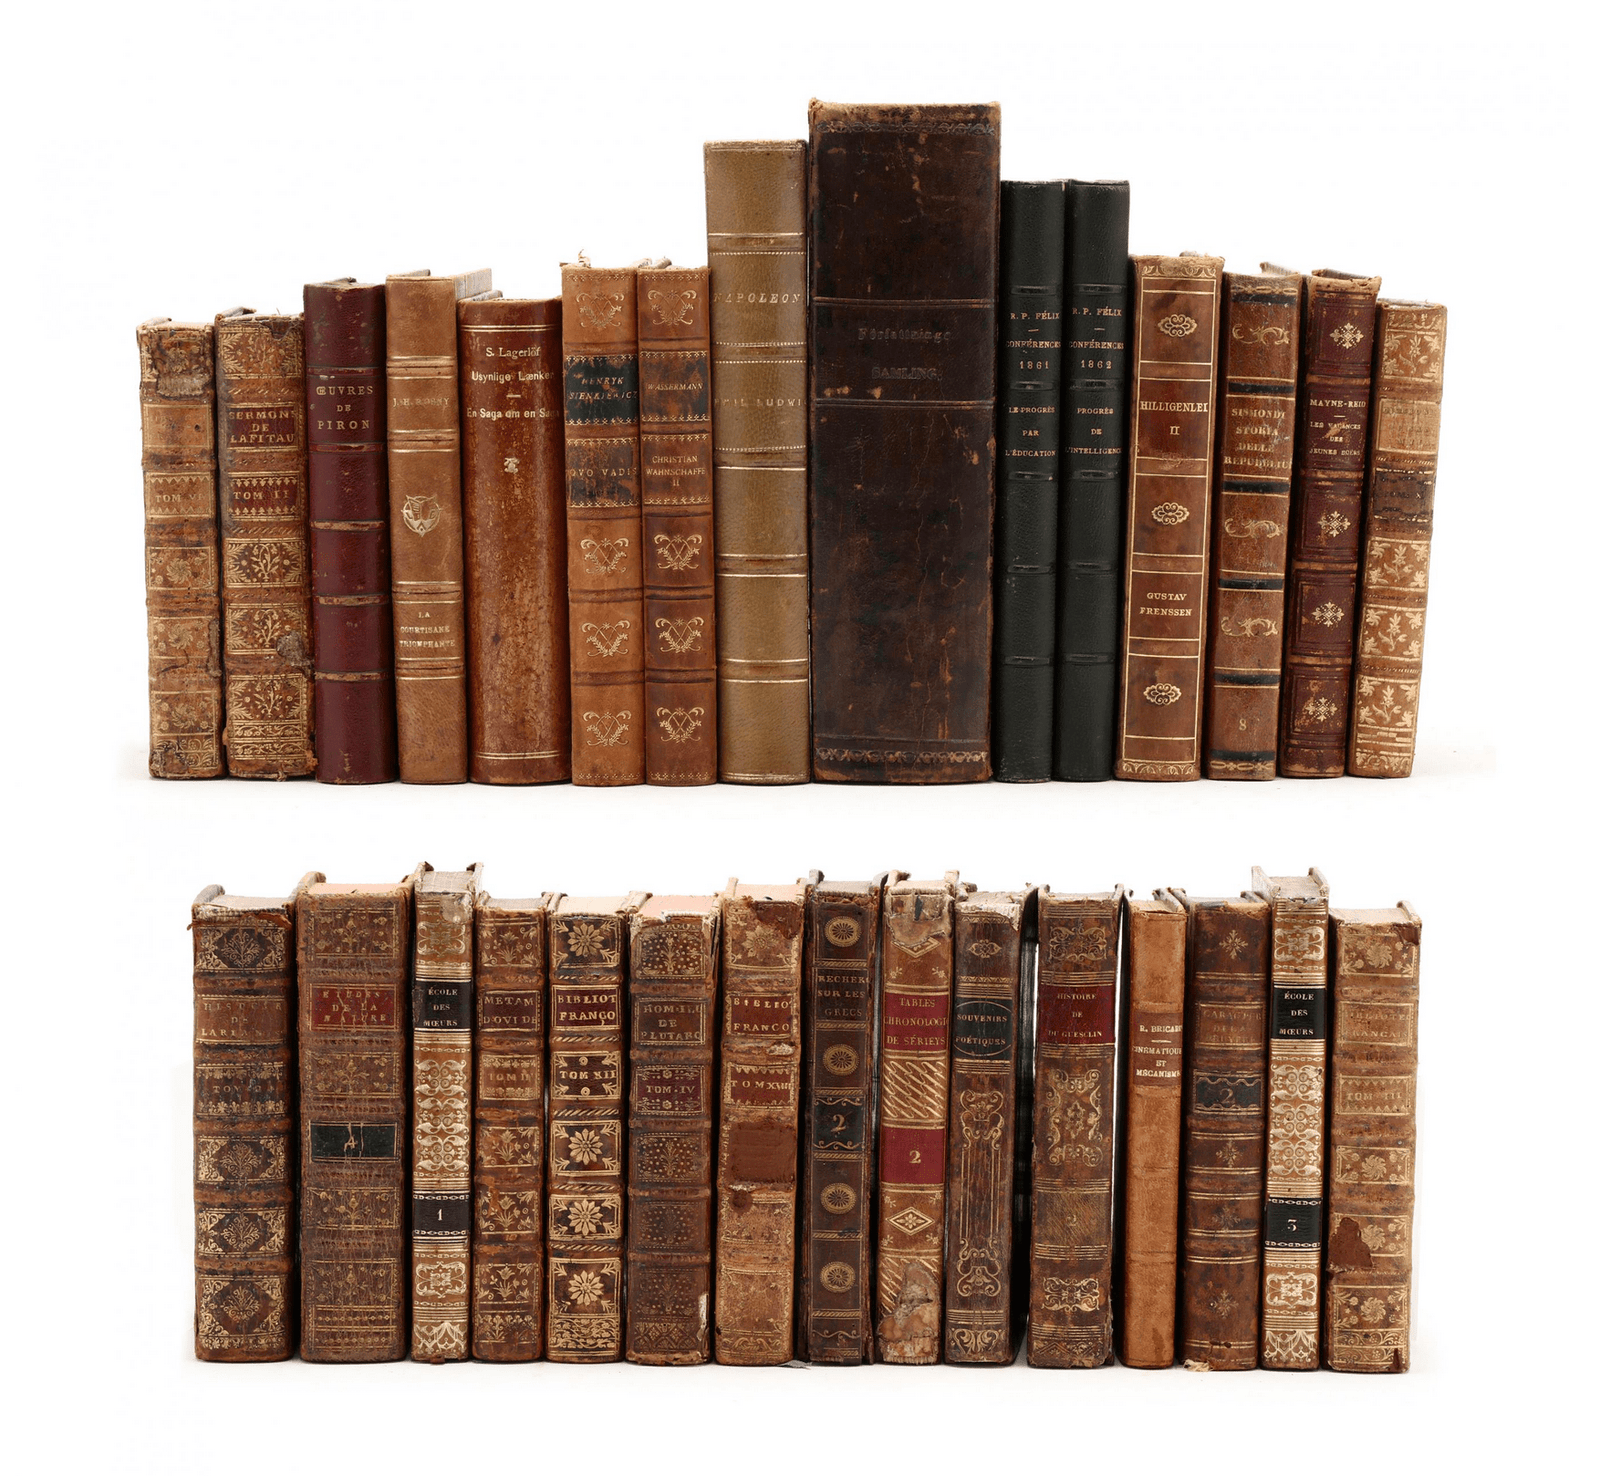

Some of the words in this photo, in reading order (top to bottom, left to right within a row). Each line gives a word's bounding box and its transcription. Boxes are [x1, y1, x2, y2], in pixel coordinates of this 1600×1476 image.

[714, 293, 800, 303] NAPOLEON
[486, 348, 495, 357] S.
[499, 347, 541, 359] Lagerlöf
[1020, 361, 1049, 369] 1861
[1081, 360, 1112, 369] 1862
[471, 371, 511, 383] Usynlige
[316, 386, 373, 395] ŒUVRES
[1140, 401, 1208, 412] HILLIGENLEI
[1310, 399, 1366, 407] MAYNE-REID
[467, 408, 477, 417] En
[479, 408, 502, 421] Saga
[524, 410, 535, 418] en
[252, 424, 269, 432] DE
[317, 420, 370, 430] PIRON
[1170, 426, 1180, 435] II
[230, 434, 294, 443] LAFITAU
[646, 468, 705, 476] WAHNSCHAFFE
[233, 491, 262, 500] TOM
[1147, 593, 1187, 601] GUSTAV
[1140, 607, 1192, 616] FRENSSEN
[1239, 719, 1247, 731] 8
[428, 987, 458, 995] ÉCOLE
[846, 990, 865, 998] LES
[1284, 991, 1314, 1000] ÉCOLE
[484, 996, 534, 1006] METAM
[558, 995, 617, 1004] BIBLIOT
[734, 998, 792, 1009] BIBLIO
[899, 997, 936, 1007] TABLES
[825, 1008, 862, 1017] GRECS
[957, 1014, 1007, 1022] SOUVENIRS
[658, 1020, 677, 1028] DE
[887, 1036, 899, 1045] DE
[904, 1034, 945, 1046] SÉRIEYS
[560, 1071, 589, 1080] TOM
[731, 1080, 764, 1088] TOM
[1220, 1088, 1235, 1104] 2
[831, 1114, 846, 1132] 2
[909, 1150, 921, 1164] 2
[437, 1209, 442, 1221] 1
